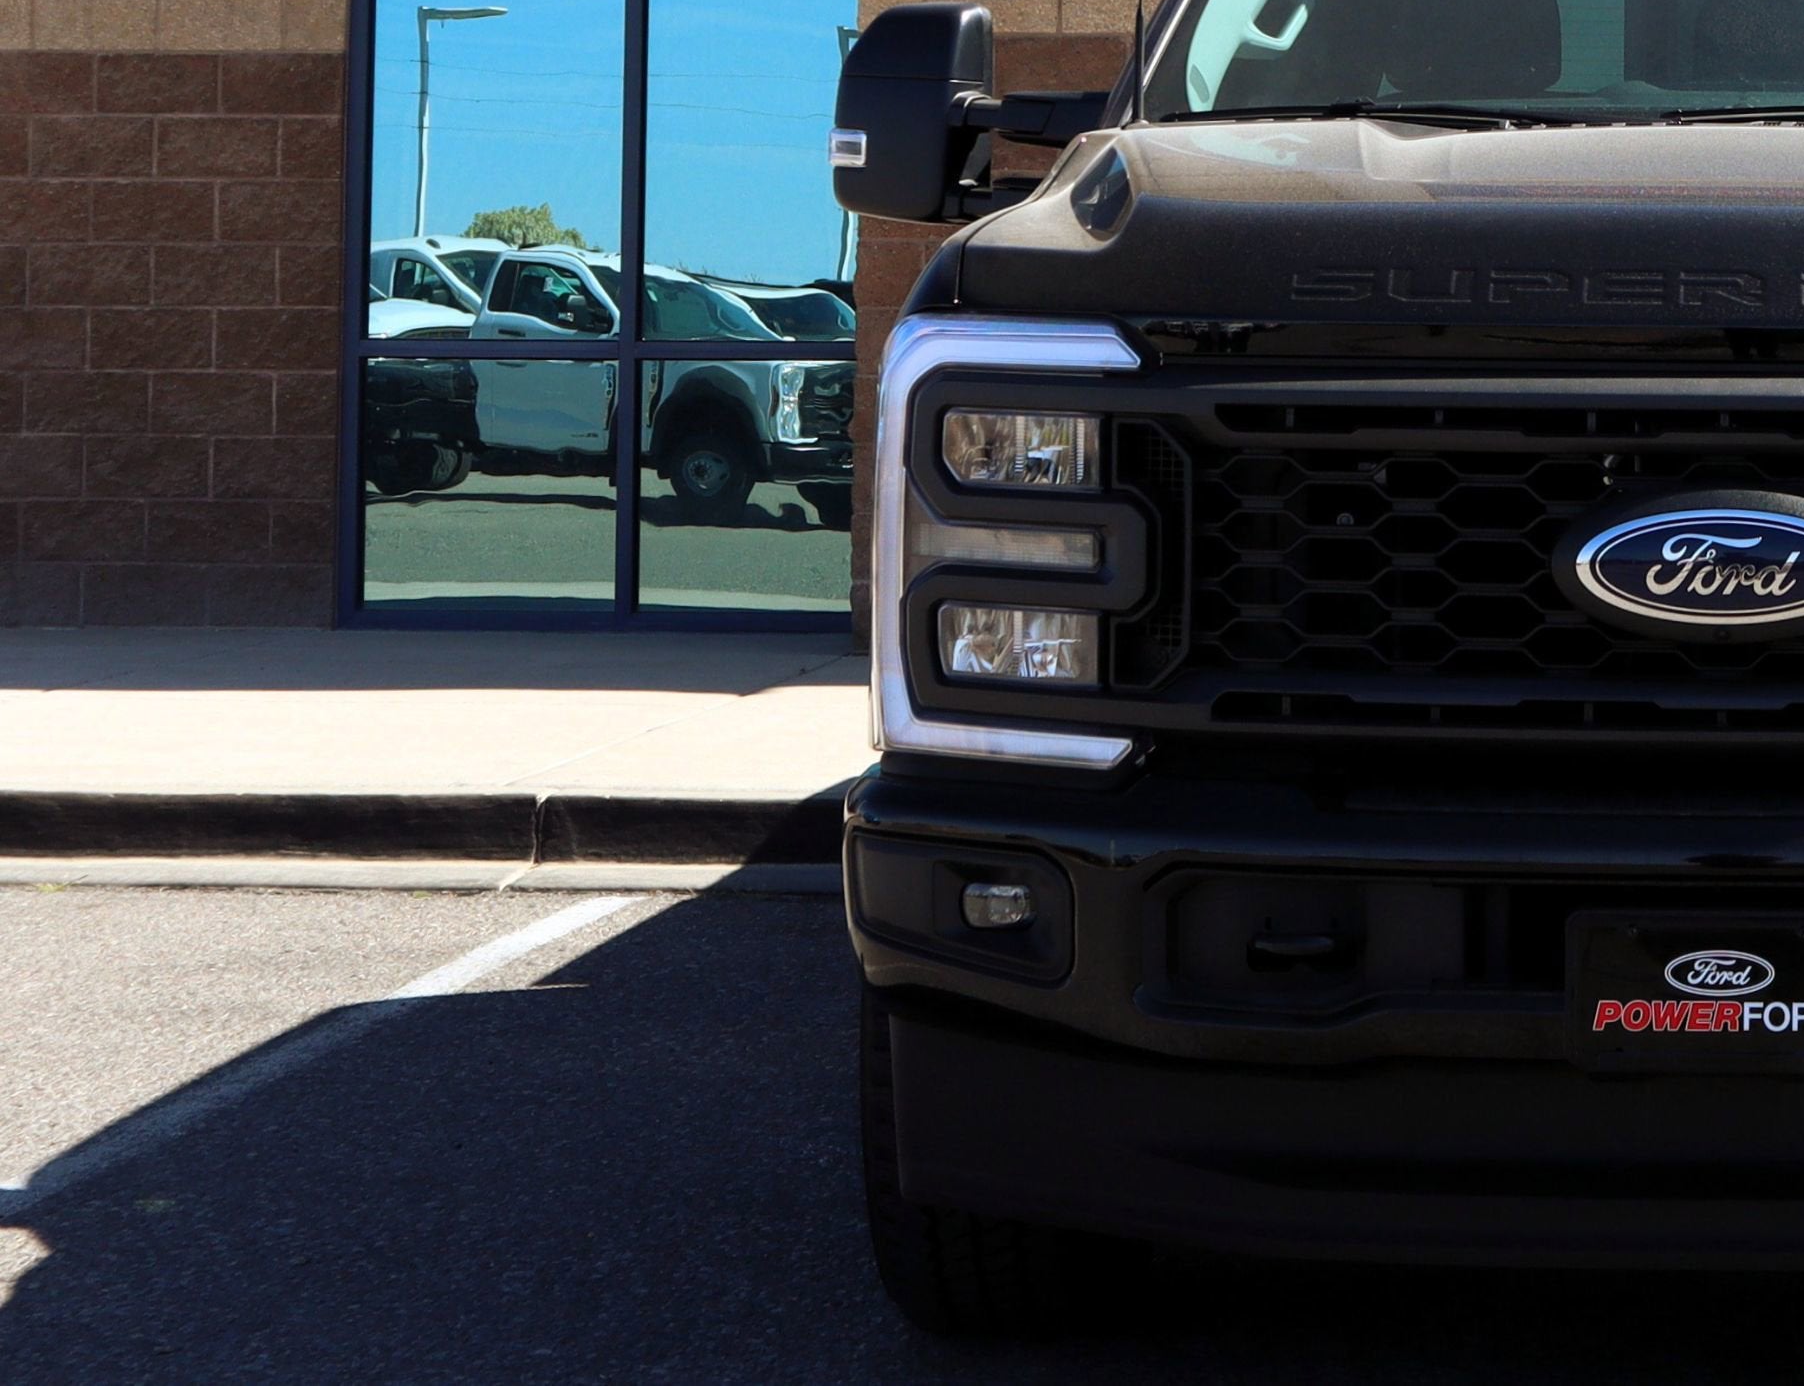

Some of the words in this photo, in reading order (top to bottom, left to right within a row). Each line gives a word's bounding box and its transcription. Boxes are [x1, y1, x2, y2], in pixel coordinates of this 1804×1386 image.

[1288, 268, 1765, 305] SUPER
[1646, 533, 1801, 597] Ford
[1687, 959, 1752, 986] Ford
